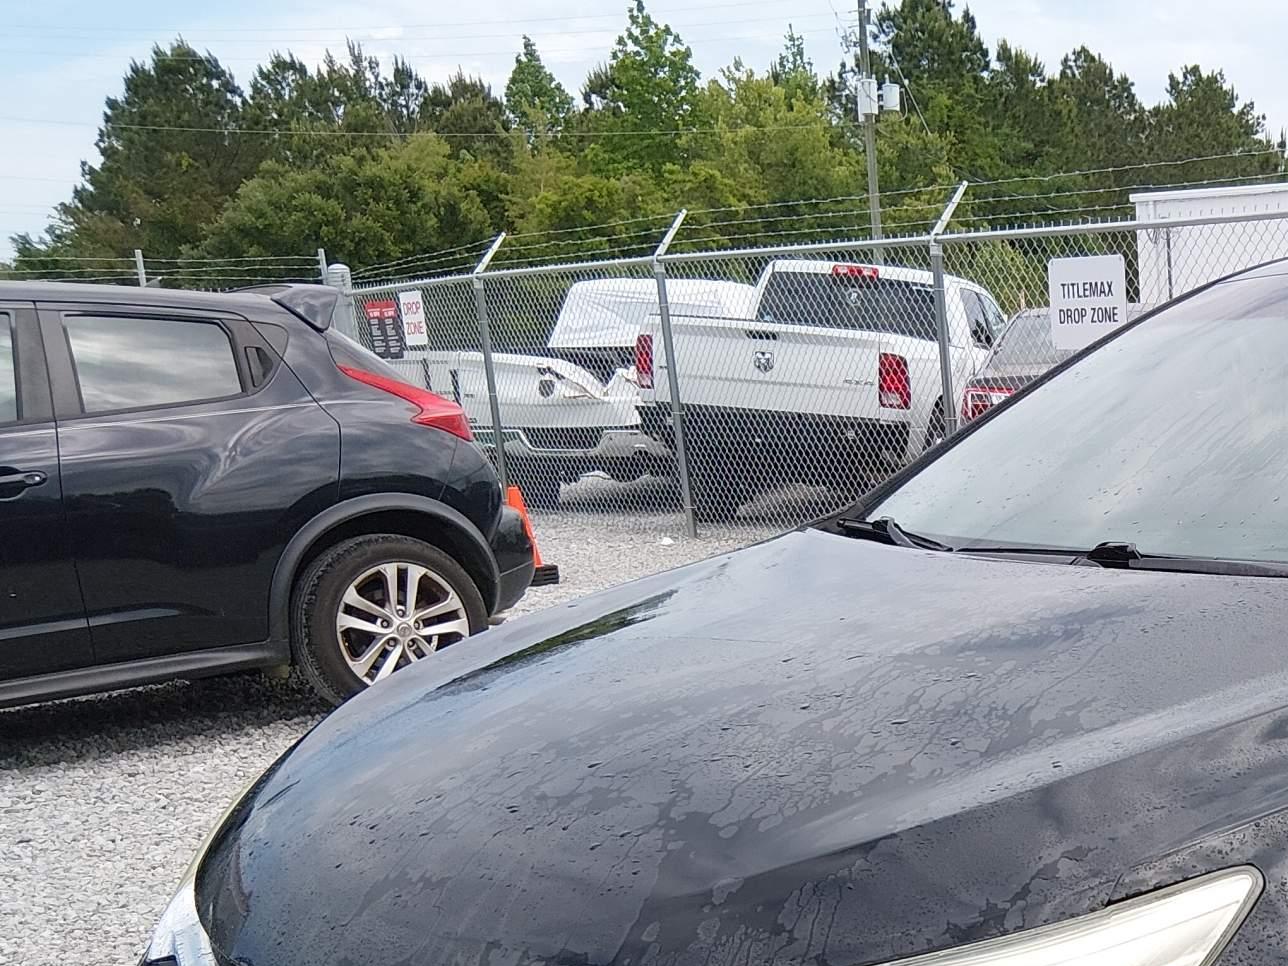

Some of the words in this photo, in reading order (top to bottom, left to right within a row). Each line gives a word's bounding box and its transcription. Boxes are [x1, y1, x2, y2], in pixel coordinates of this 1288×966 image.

[1060, 281, 1114, 299] TITLEMAX
[402, 301, 420, 315] DROP
[1058, 308, 1088, 325] DROP
[1090, 306, 1119, 324] ZONE
[405, 321, 424, 335] ZONE
